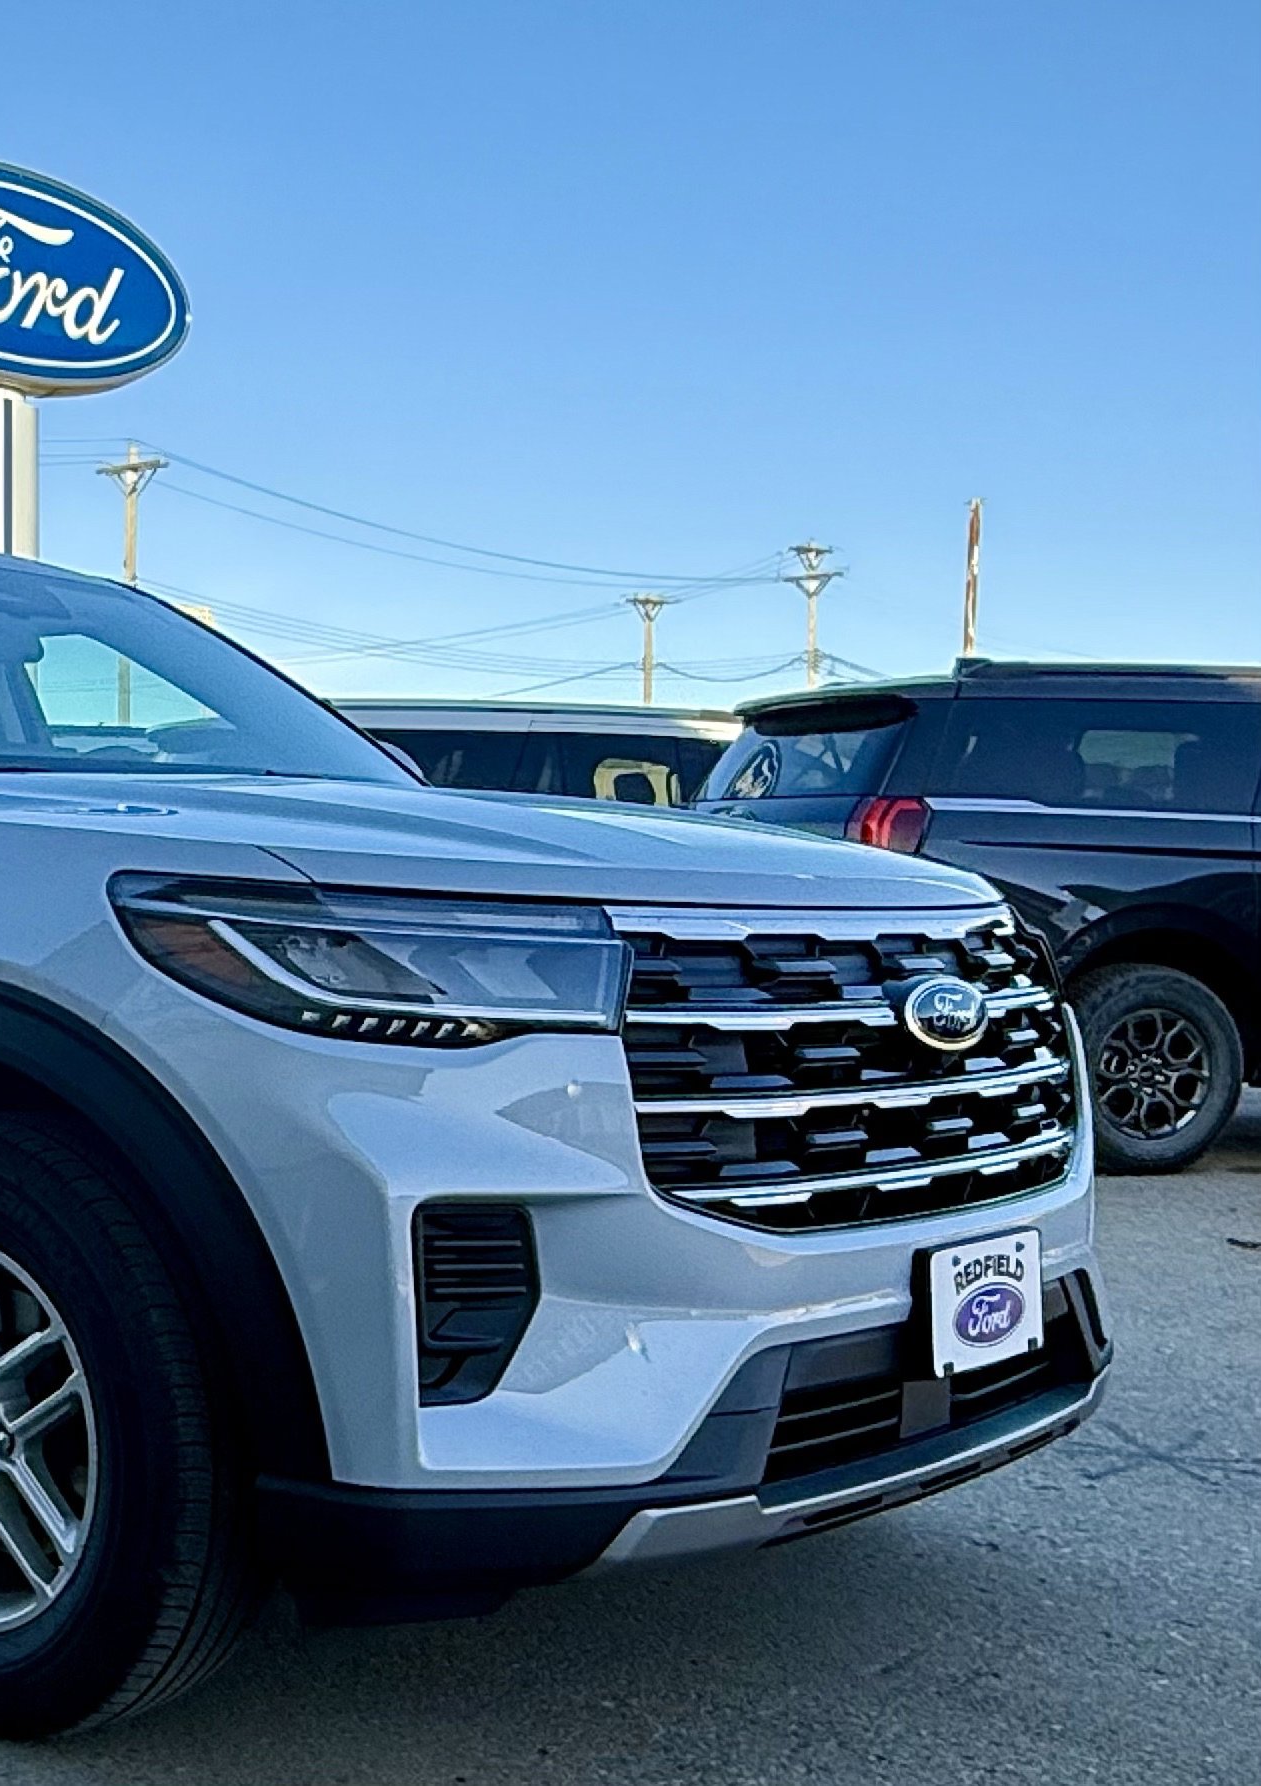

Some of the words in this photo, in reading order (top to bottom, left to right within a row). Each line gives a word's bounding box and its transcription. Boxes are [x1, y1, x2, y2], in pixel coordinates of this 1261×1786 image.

[933, 993, 977, 1032] Ford
[953, 1254, 1025, 1296] REDFIELD
[967, 1293, 1012, 1337] Ford
